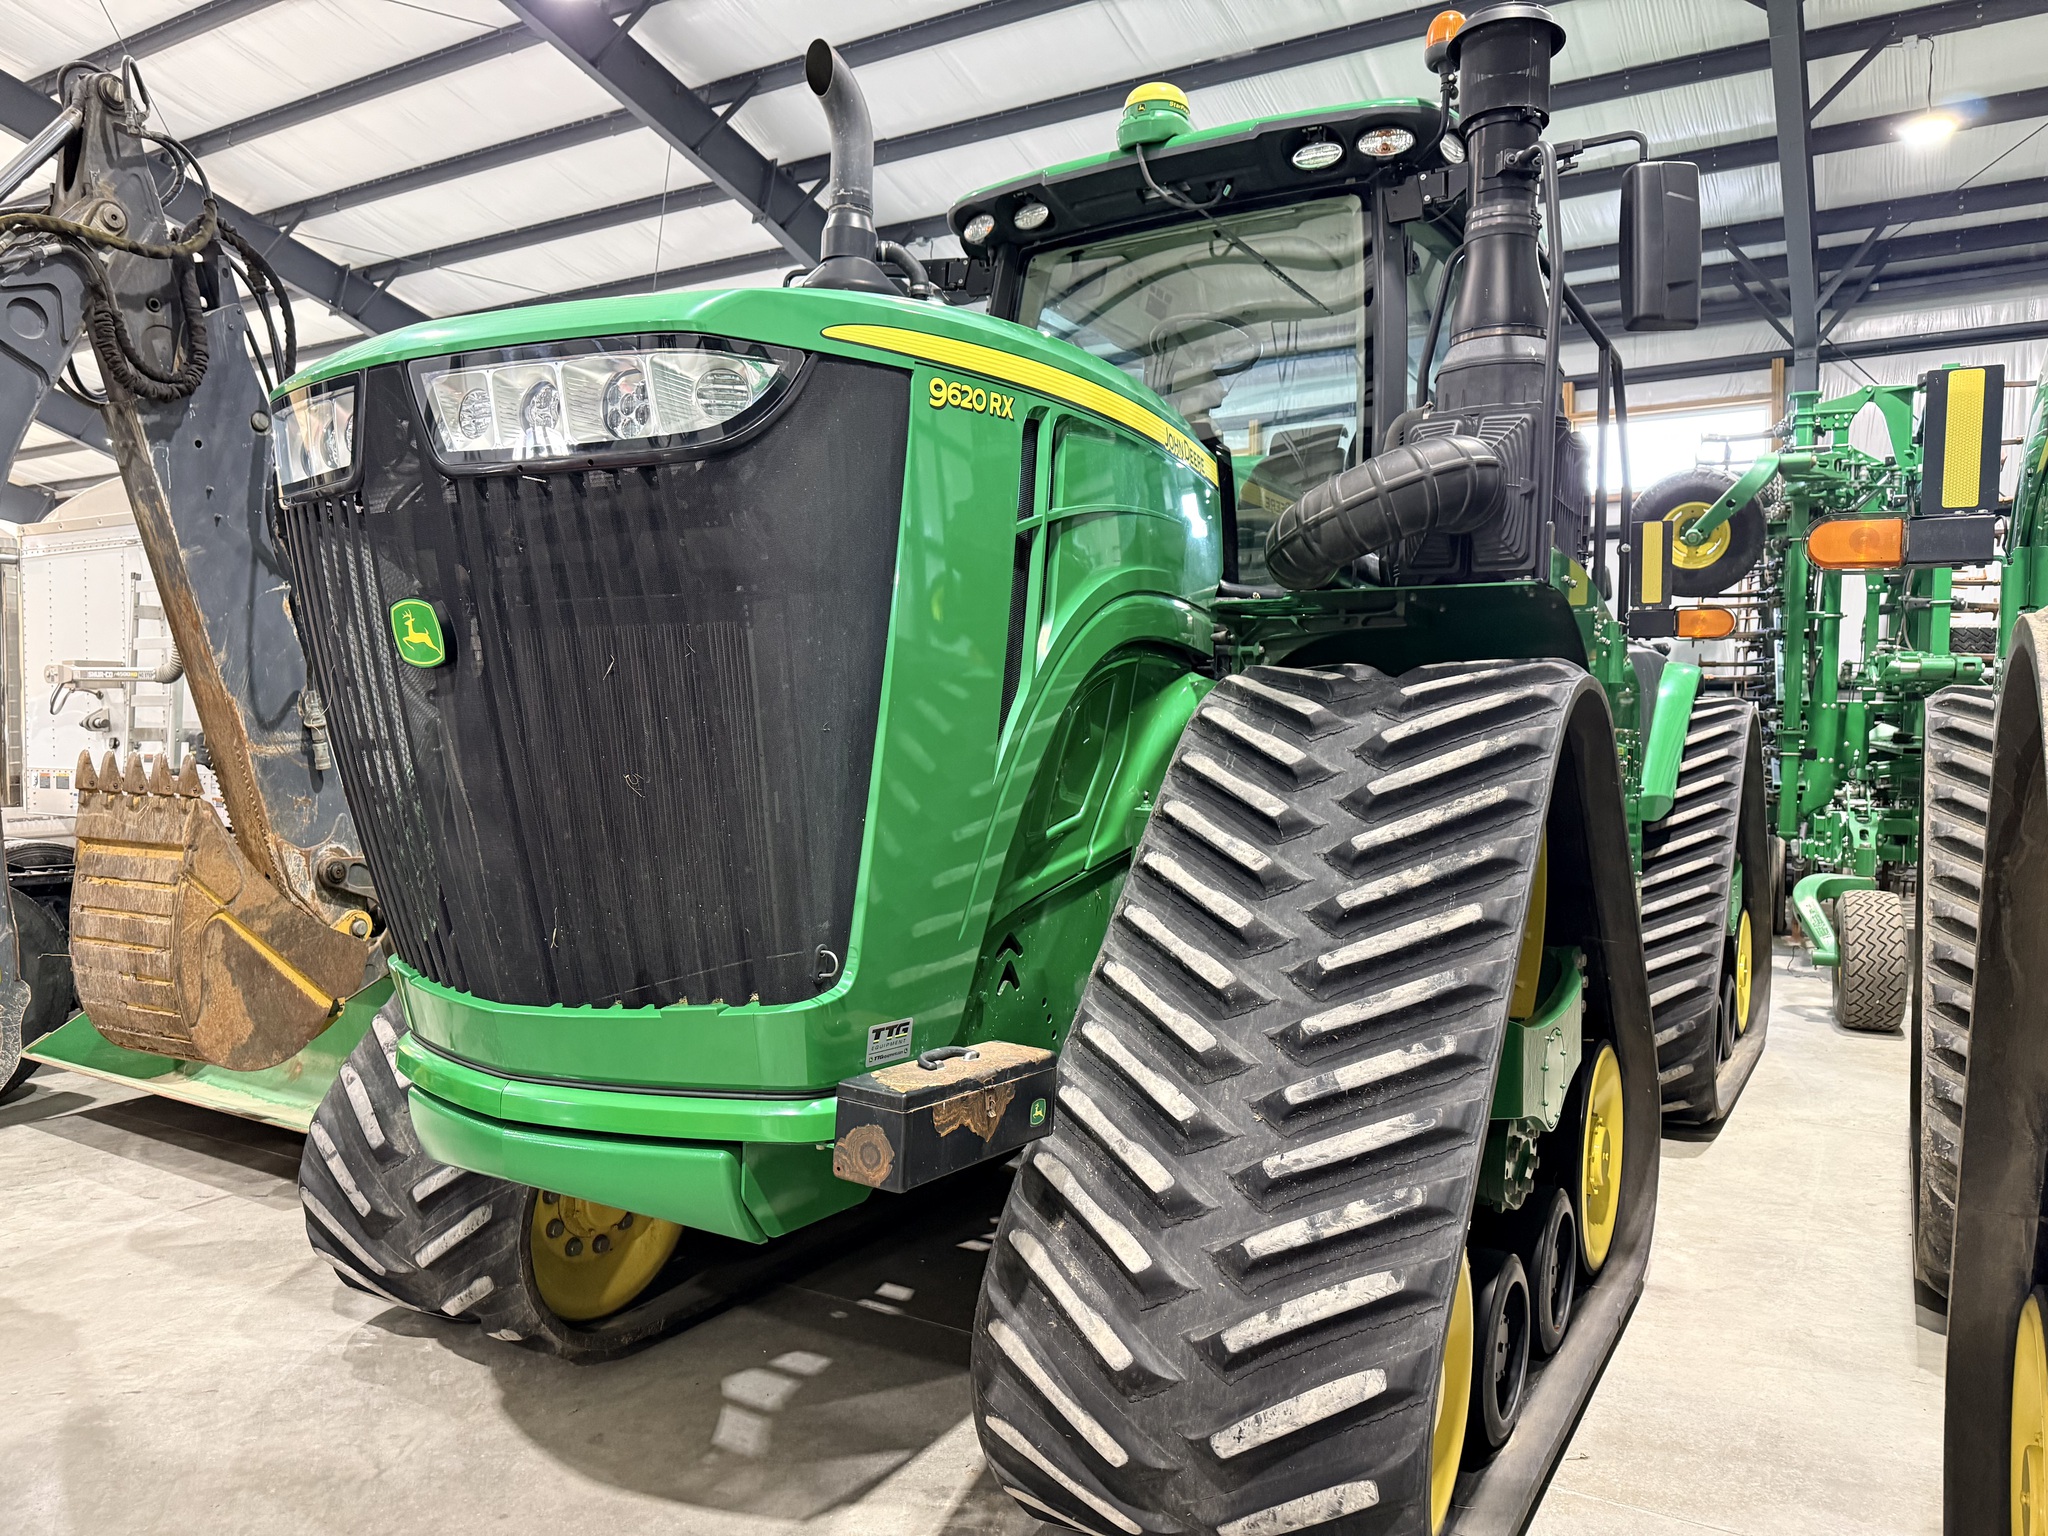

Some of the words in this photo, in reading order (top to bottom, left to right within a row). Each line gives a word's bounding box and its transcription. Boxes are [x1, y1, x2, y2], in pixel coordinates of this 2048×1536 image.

[929, 377, 987, 412] 9620
[989, 391, 1015, 420] RX
[1165, 426, 1184, 461] JOHN
[1183, 439, 1206, 475] DEERE
[871, 1038, 906, 1051] EQUIPMENT
[872, 1021, 910, 1044] TTG
